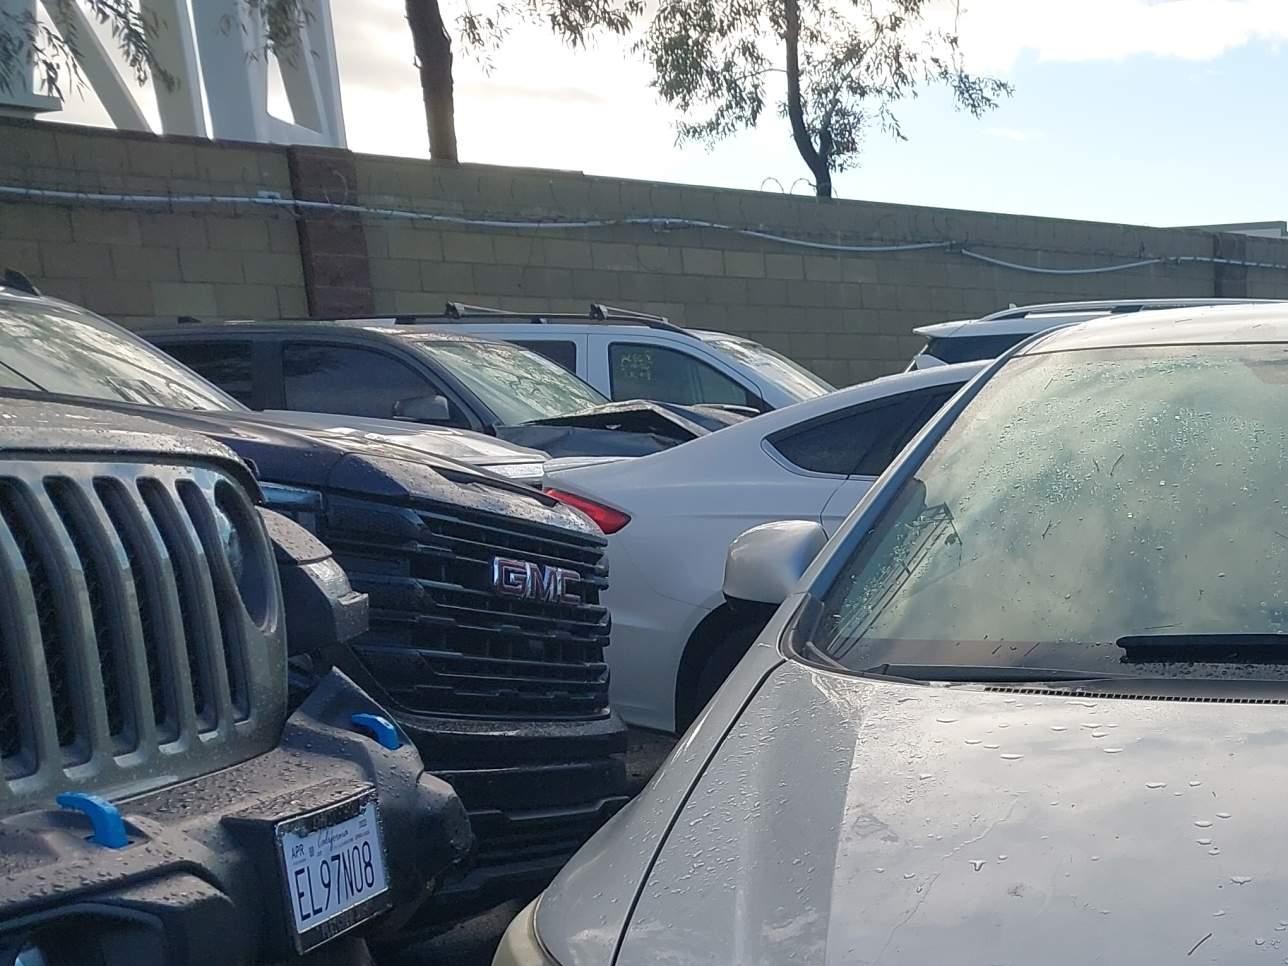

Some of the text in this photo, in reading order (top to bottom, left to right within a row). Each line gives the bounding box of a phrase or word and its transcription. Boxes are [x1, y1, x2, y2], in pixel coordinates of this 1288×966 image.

[492, 556, 581, 605] GMC
[291, 843, 306, 860] APR
[294, 840, 375, 922] EL97N08
